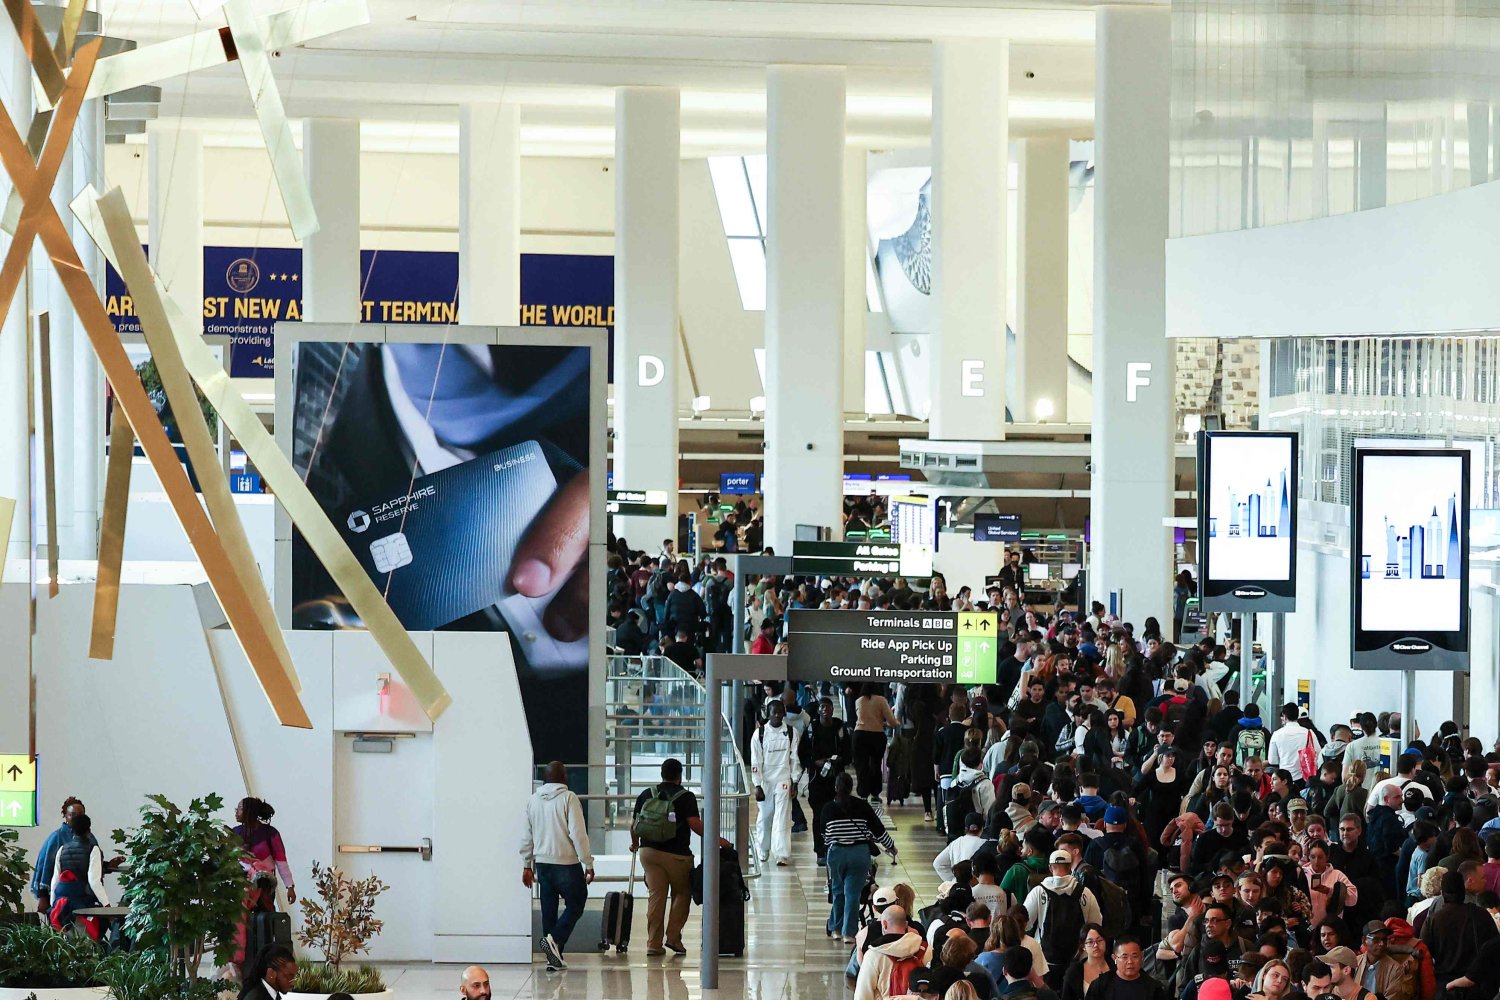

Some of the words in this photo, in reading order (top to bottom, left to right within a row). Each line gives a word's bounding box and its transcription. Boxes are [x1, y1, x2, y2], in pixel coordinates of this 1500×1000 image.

[234, 298, 281, 319] NEW
[208, 325, 267, 333] demonstrate
[638, 355, 665, 387] D
[961, 360, 985, 396] E
[1126, 362, 1151, 402] F
[494, 453, 536, 472] BUSINESS
[727, 477, 749, 486] porter
[372, 485, 436, 515] SAPPHIRE
[375, 502, 419, 524] RESERVE
[867, 617, 920, 629] Terminals
[923, 619, 932, 628] A
[934, 619, 942, 628] B
[945, 620, 953, 628] C
[861, 639, 885, 649] Ride
[888, 640, 909, 651] App
[912, 640, 934, 650] Pick
[937, 641, 953, 652] Up
[900, 655, 941, 666] Parking
[830, 666, 871, 677] Ground
[874, 668, 953, 680] Transportation
